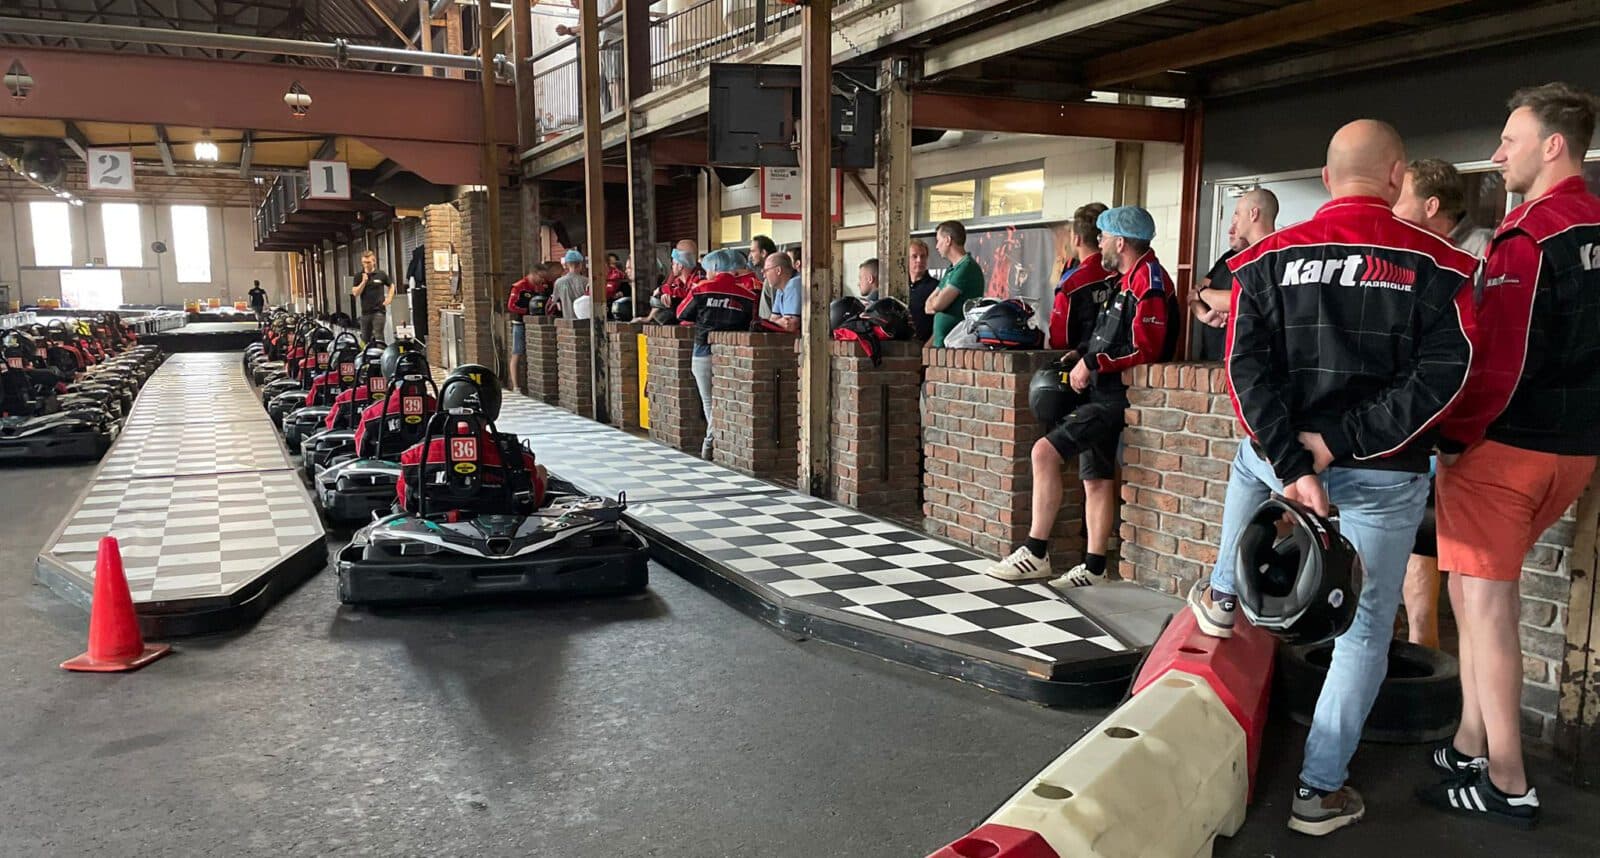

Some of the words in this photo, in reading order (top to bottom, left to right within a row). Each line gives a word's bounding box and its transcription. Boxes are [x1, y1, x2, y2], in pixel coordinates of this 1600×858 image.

[98, 154, 123, 186] 2
[321, 166, 337, 193] 1
[1279, 254, 1363, 287] Kart
[1360, 281, 1412, 292] FABRIQUE
[706, 297, 730, 309] Kart
[405, 399, 421, 412] 39
[453, 440, 474, 458] 36
